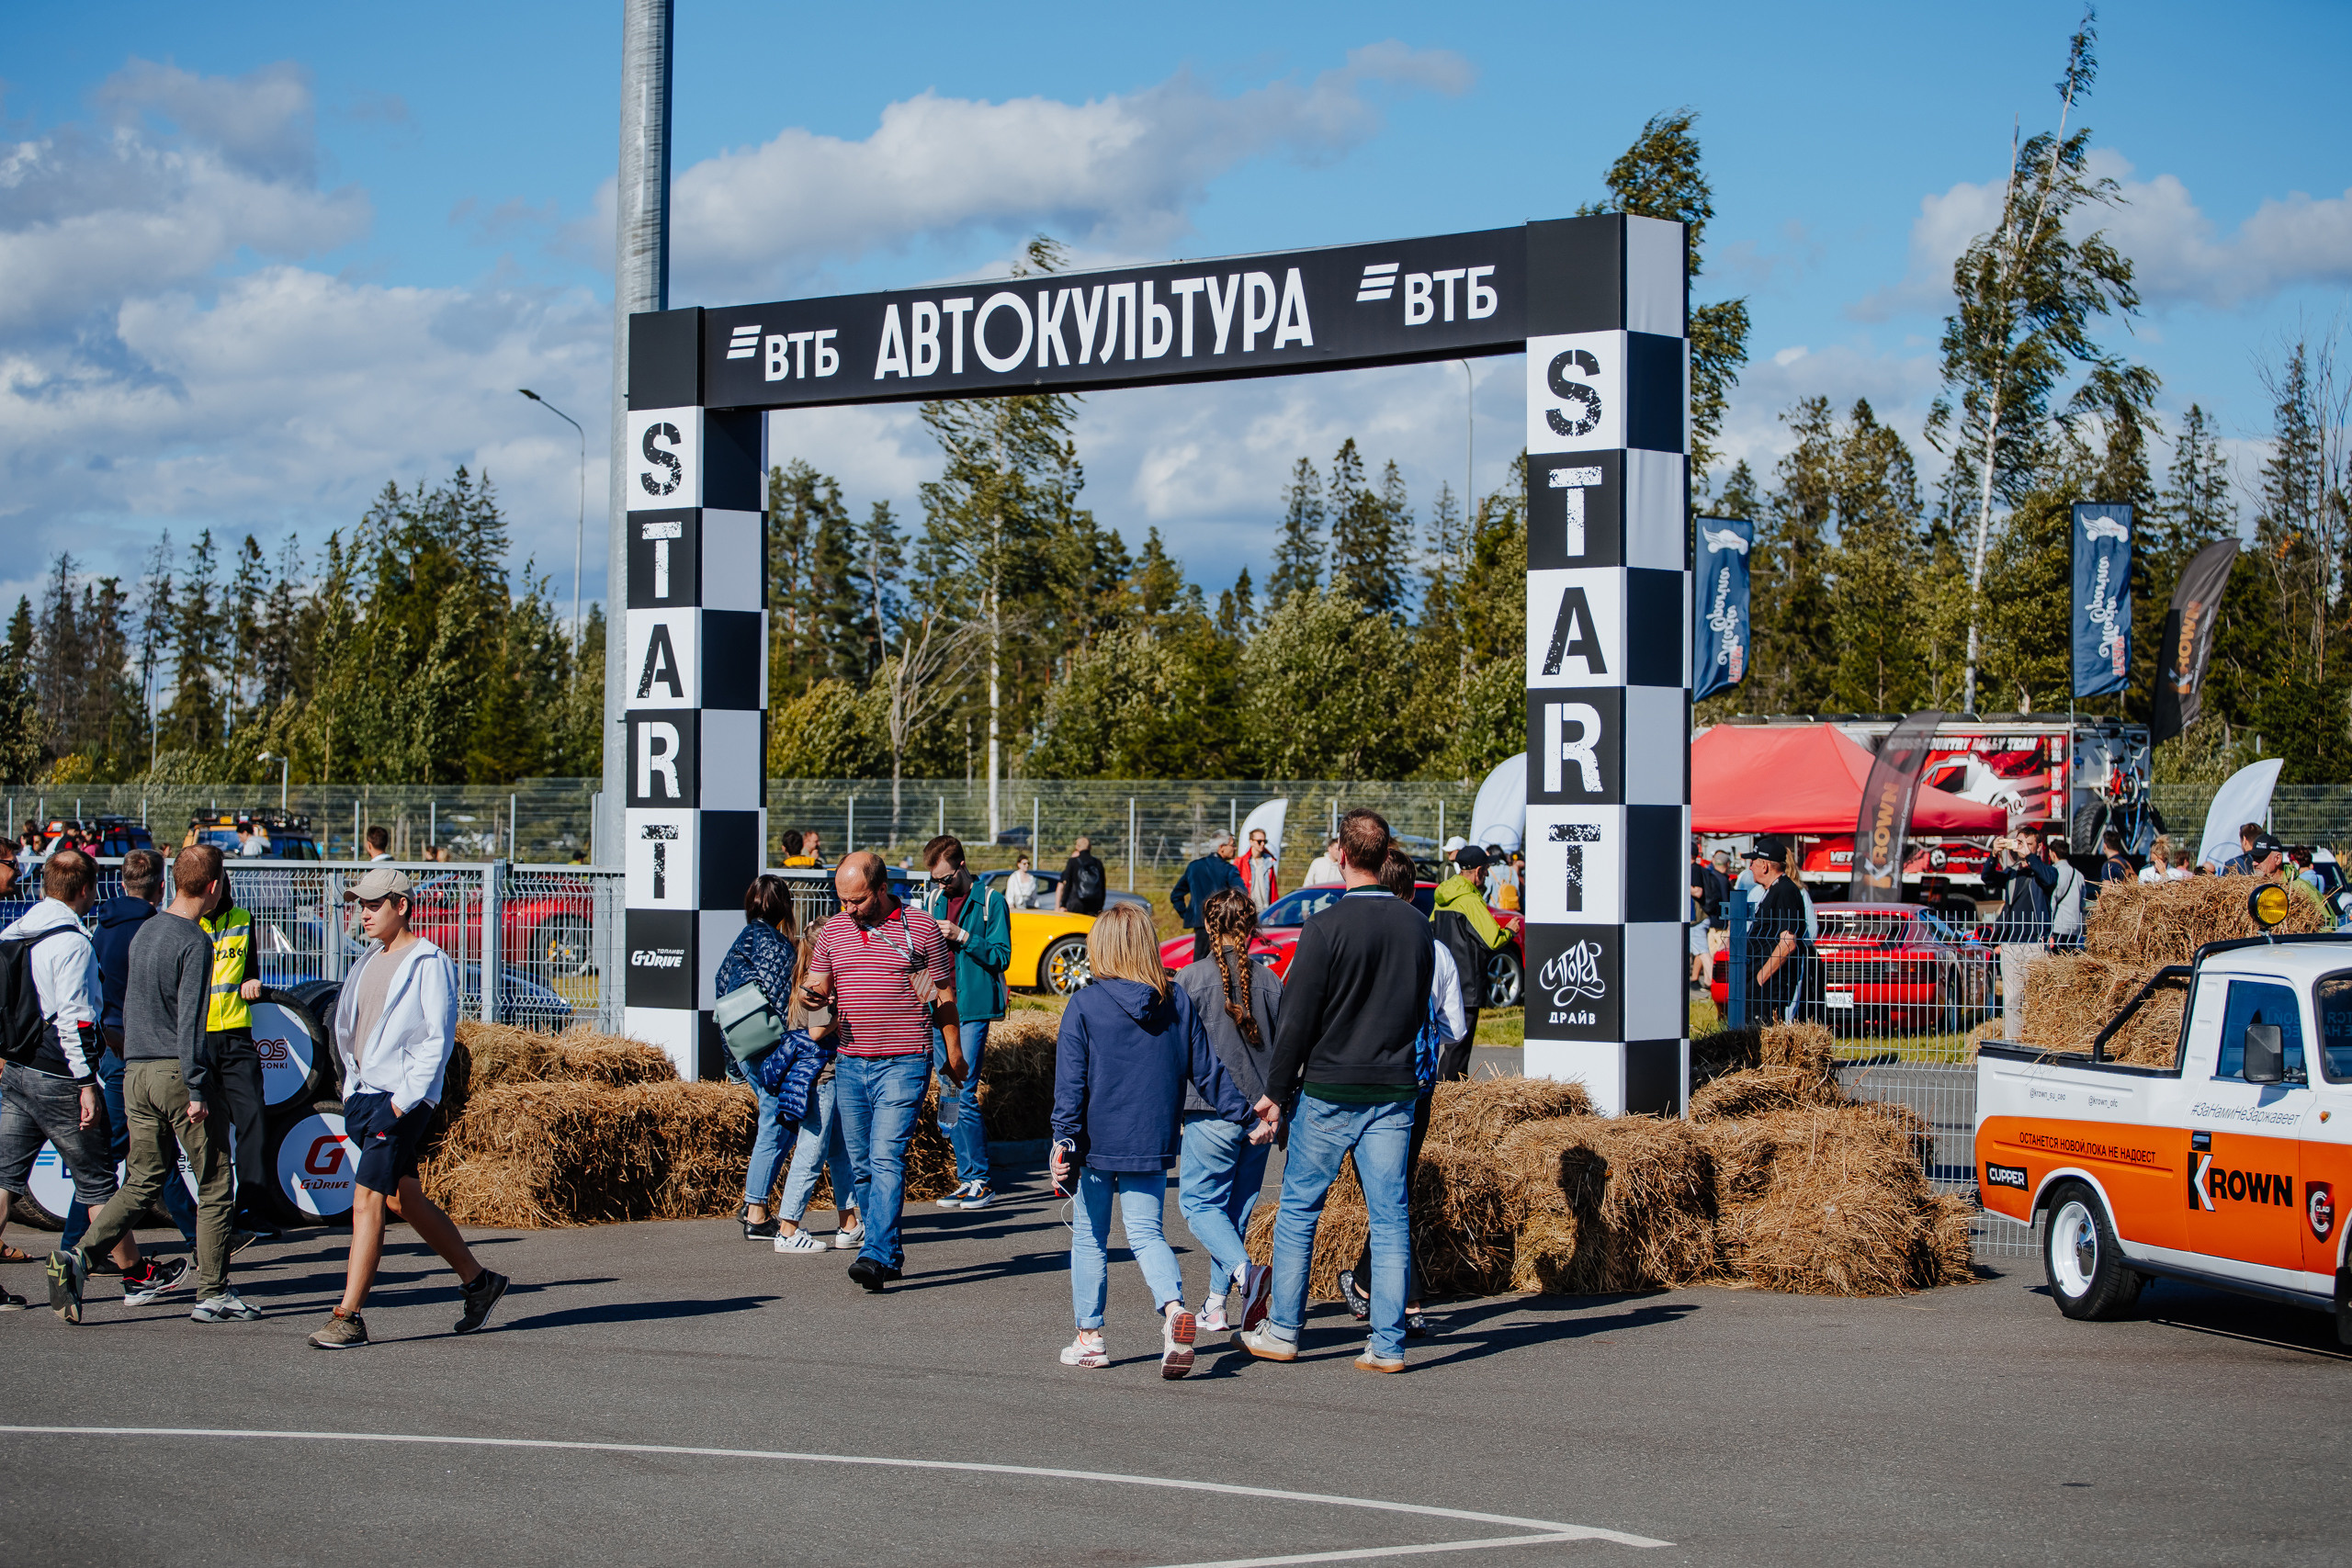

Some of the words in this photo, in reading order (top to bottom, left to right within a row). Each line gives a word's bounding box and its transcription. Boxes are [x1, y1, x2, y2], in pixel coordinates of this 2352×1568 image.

[765, 328, 840, 382] ВТБ
[874, 267, 1314, 380] АВТОКУЛЬТУРА
[1404, 265, 1498, 326] ВТБ
[1542, 348, 1607, 912] START
[636, 422, 684, 899] START
[2007, 737, 2039, 751] TEAM
[1548, 1010, 1596, 1025] ДРАЙВ
[2190, 1101, 2301, 1126] #ЗаНамиНеЗаржавеет
[2018, 1132, 2059, 1149] ОСТАНЕТСЯ
[2109, 1146, 2119, 1158] НЕ
[2120, 1147, 2156, 1164] НАДОЕСТ
[1989, 1167, 2025, 1186] CUPPER
[2188, 1151, 2293, 1213] KROWN
